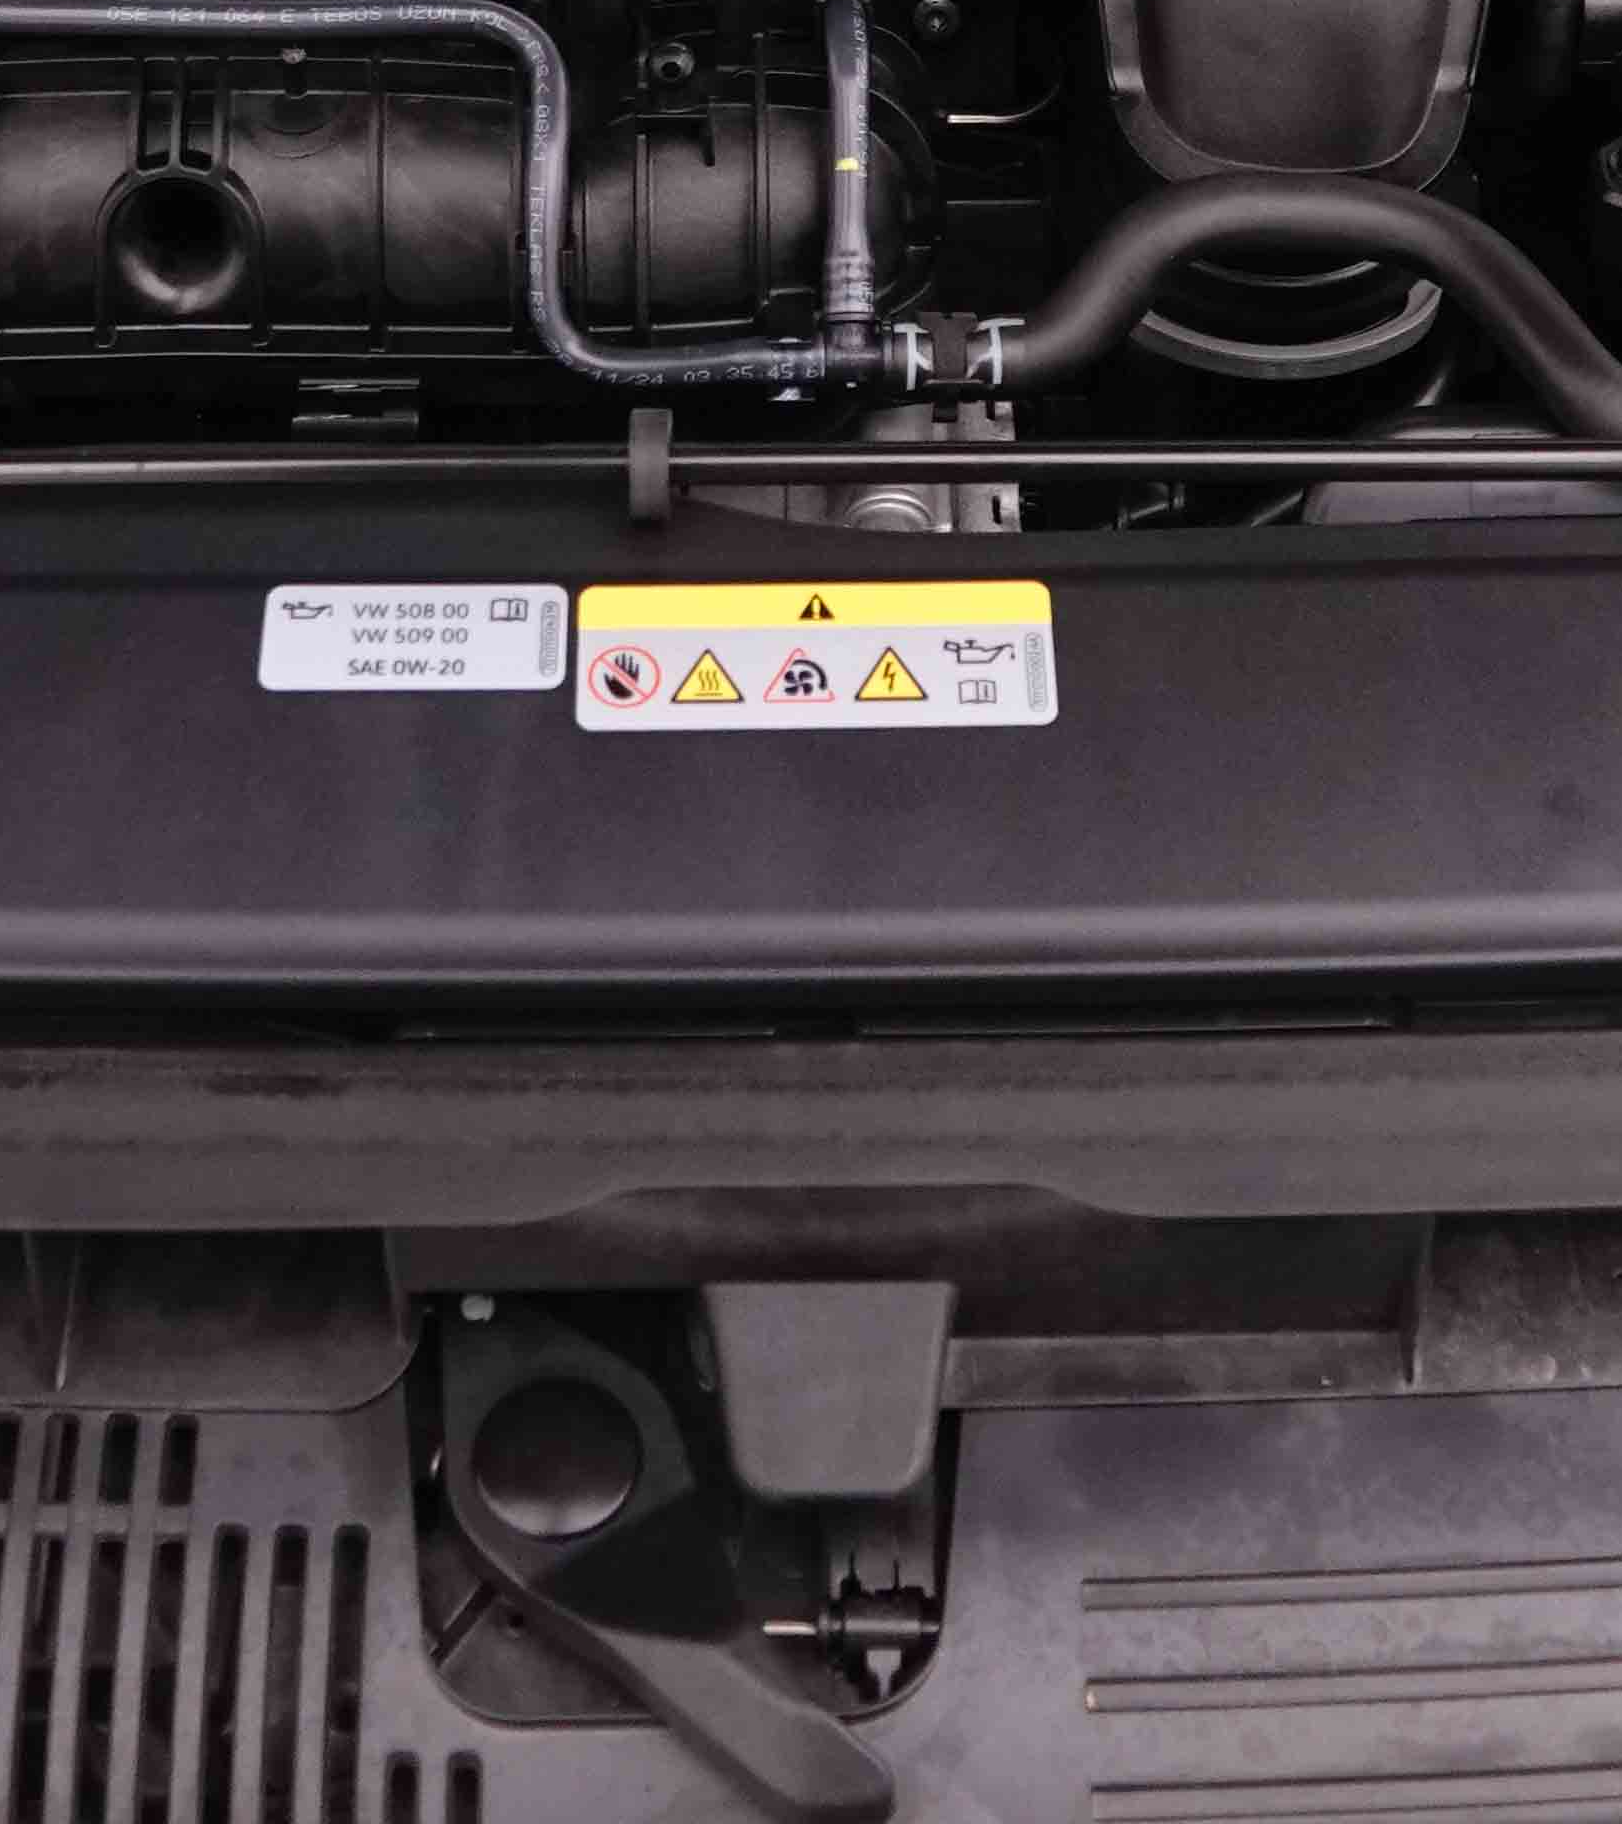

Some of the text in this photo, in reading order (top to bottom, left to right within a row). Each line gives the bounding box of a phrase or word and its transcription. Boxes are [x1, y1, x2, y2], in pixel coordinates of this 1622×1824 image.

[352, 603, 470, 619] VW 508 00
[351, 628, 469, 644] VW 509 00
[348, 659, 466, 676] SAE 0W-20
